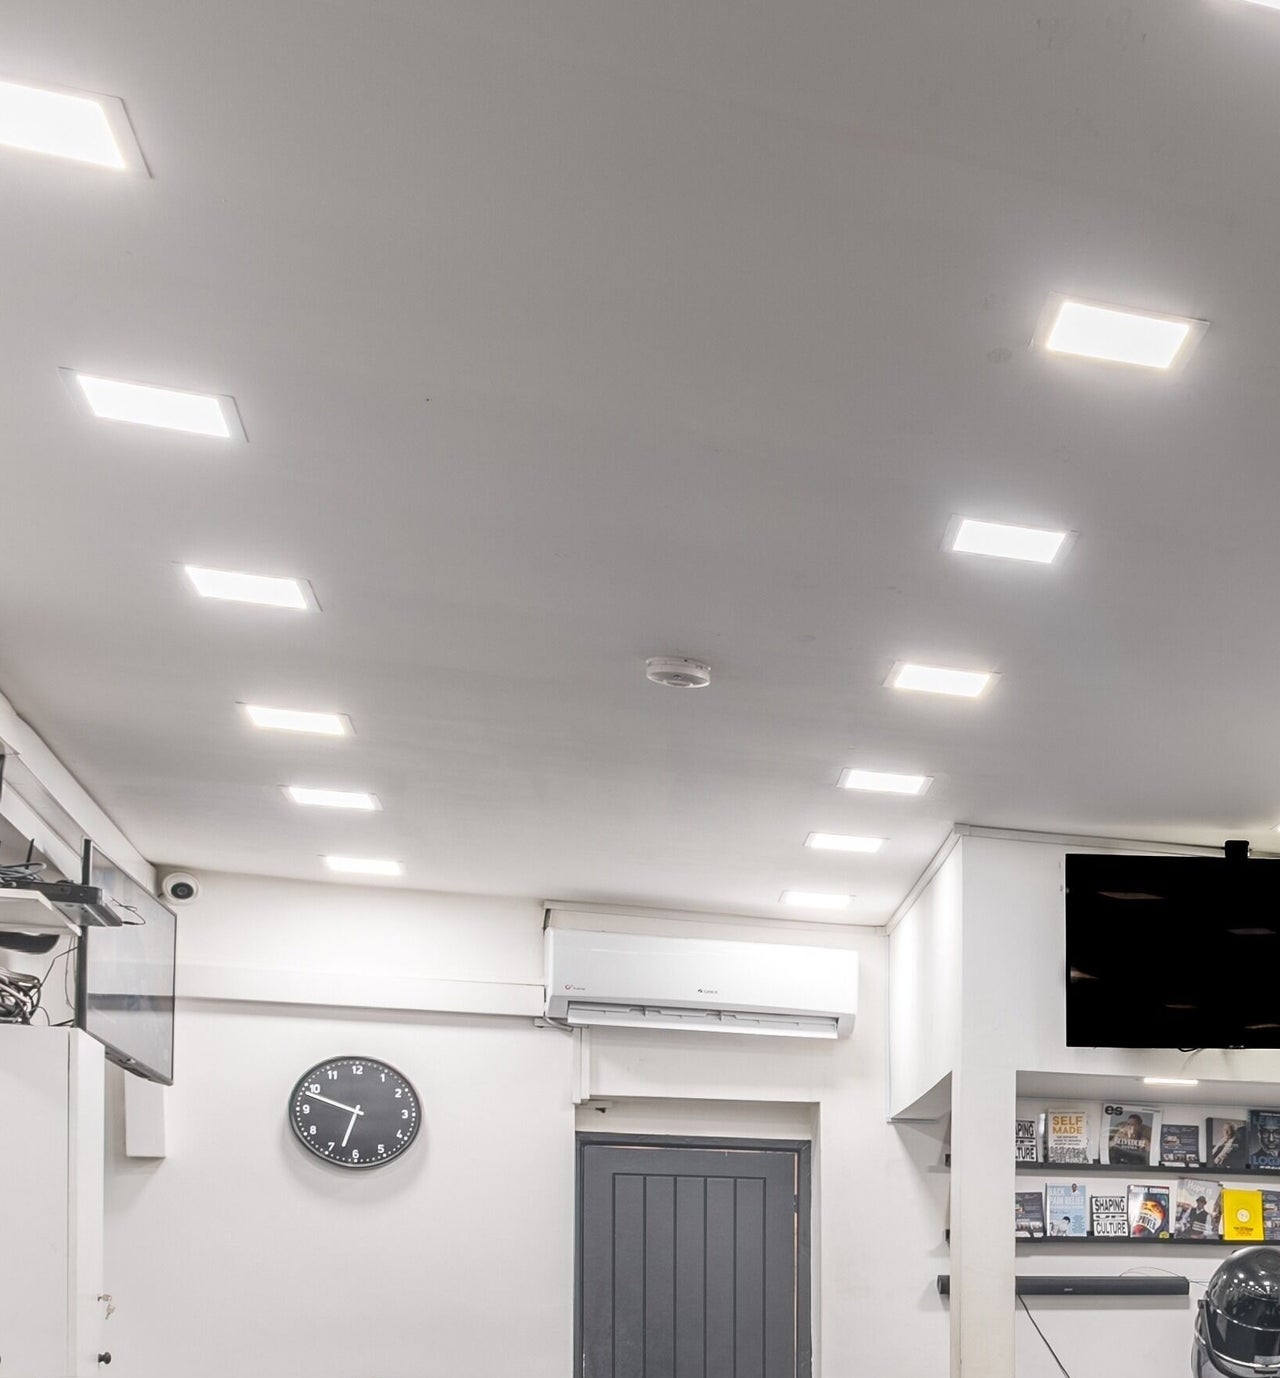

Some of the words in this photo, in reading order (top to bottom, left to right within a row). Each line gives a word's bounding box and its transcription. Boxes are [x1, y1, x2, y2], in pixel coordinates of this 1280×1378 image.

[328, 1070, 338, 1080] 11
[352, 1066, 364, 1075] 12
[380, 1074, 386, 1082] 1
[310, 1084, 320, 1094] 10
[394, 1088, 402, 1098] 2
[302, 1104, 310, 1114] 9
[1104, 1105, 1124, 1116] es
[402, 1110, 408, 1119] 3
[1052, 1116, 1084, 1126] SELF
[310, 1126, 316, 1135] 8
[396, 1129, 402, 1138] 4
[1016, 1123, 1034, 1137] PING
[1052, 1126, 1082, 1134] MADE
[328, 1142, 335, 1151] 7
[378, 1144, 384, 1154] 5
[352, 1150, 360, 1158] 6
[1094, 1198, 1125, 1212] SHAPING
[1096, 1222, 1126, 1235] CULTURE
